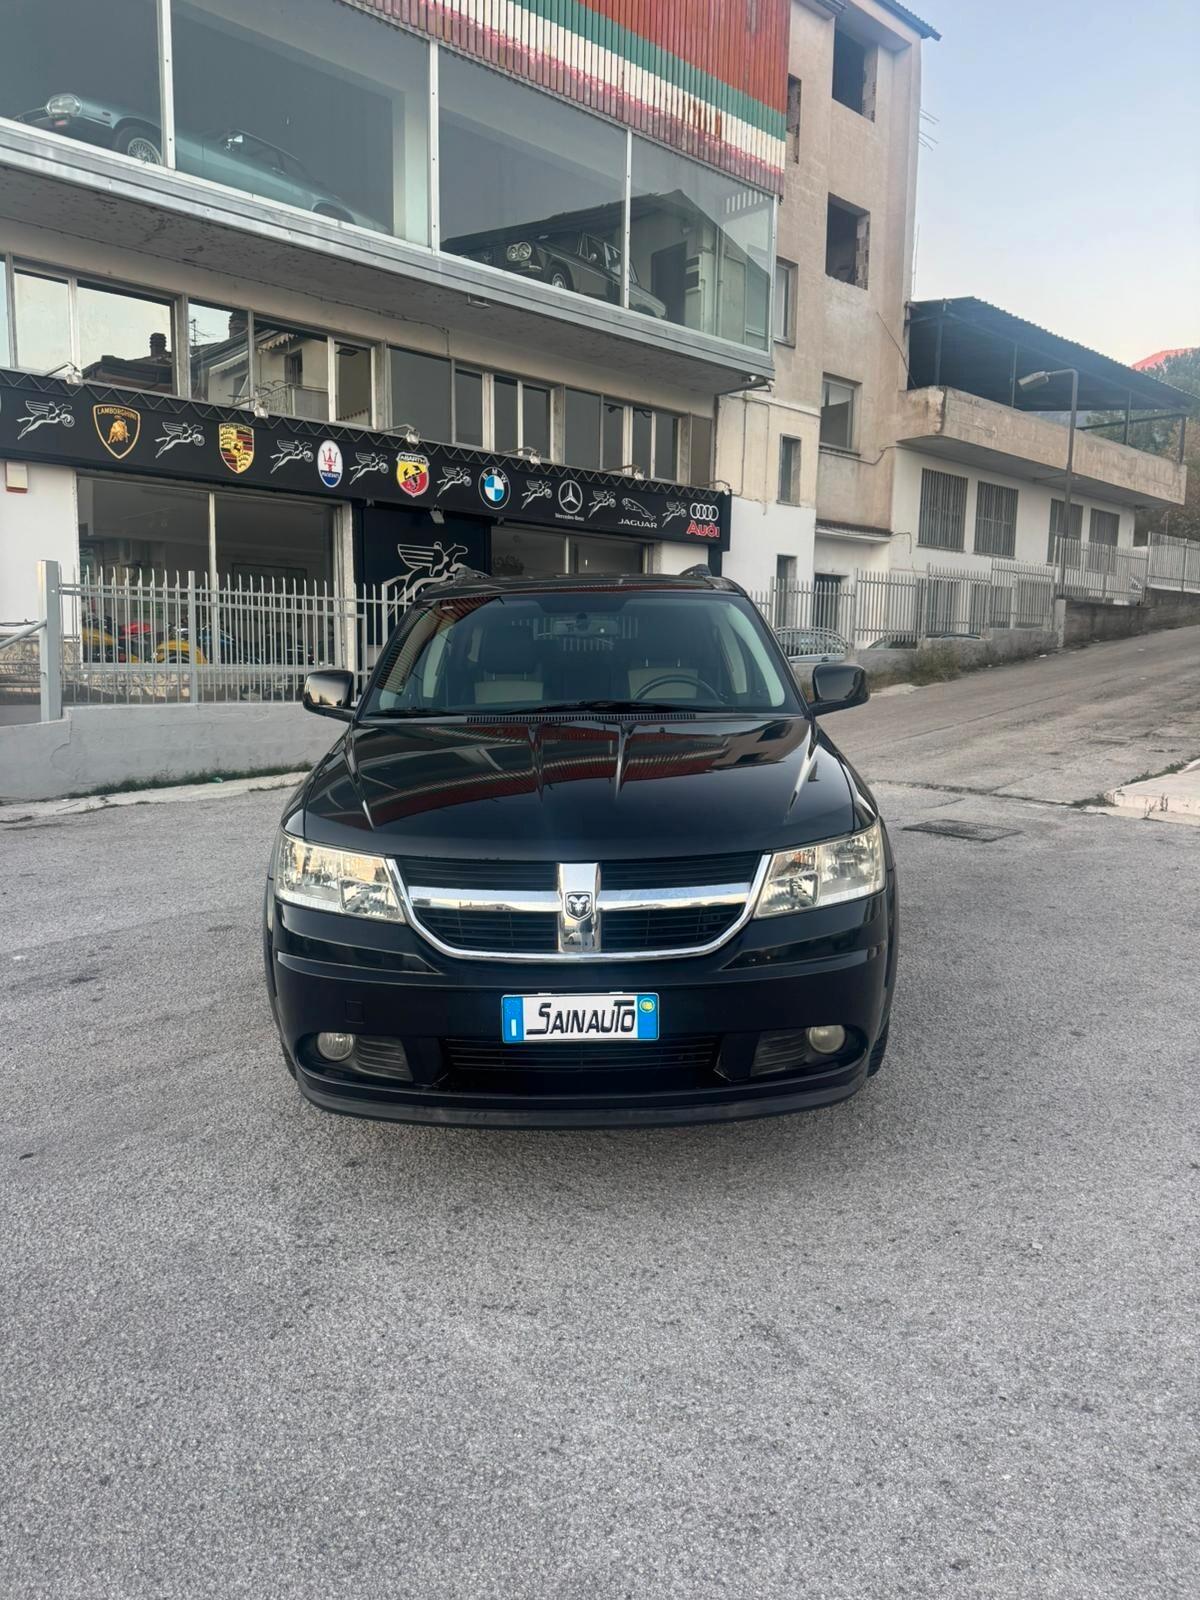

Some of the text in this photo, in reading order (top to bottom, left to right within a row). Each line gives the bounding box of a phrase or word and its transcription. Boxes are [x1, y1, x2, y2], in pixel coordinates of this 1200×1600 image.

[97, 408, 136, 420] LAMBORGHINI
[481, 468, 508, 483] BMW
[554, 512, 585, 521] Mercedes-Benz
[618, 518, 658, 529] JAGUAR
[686, 520, 720, 537] Audi
[526, 1000, 636, 1035] SAINAUTO
